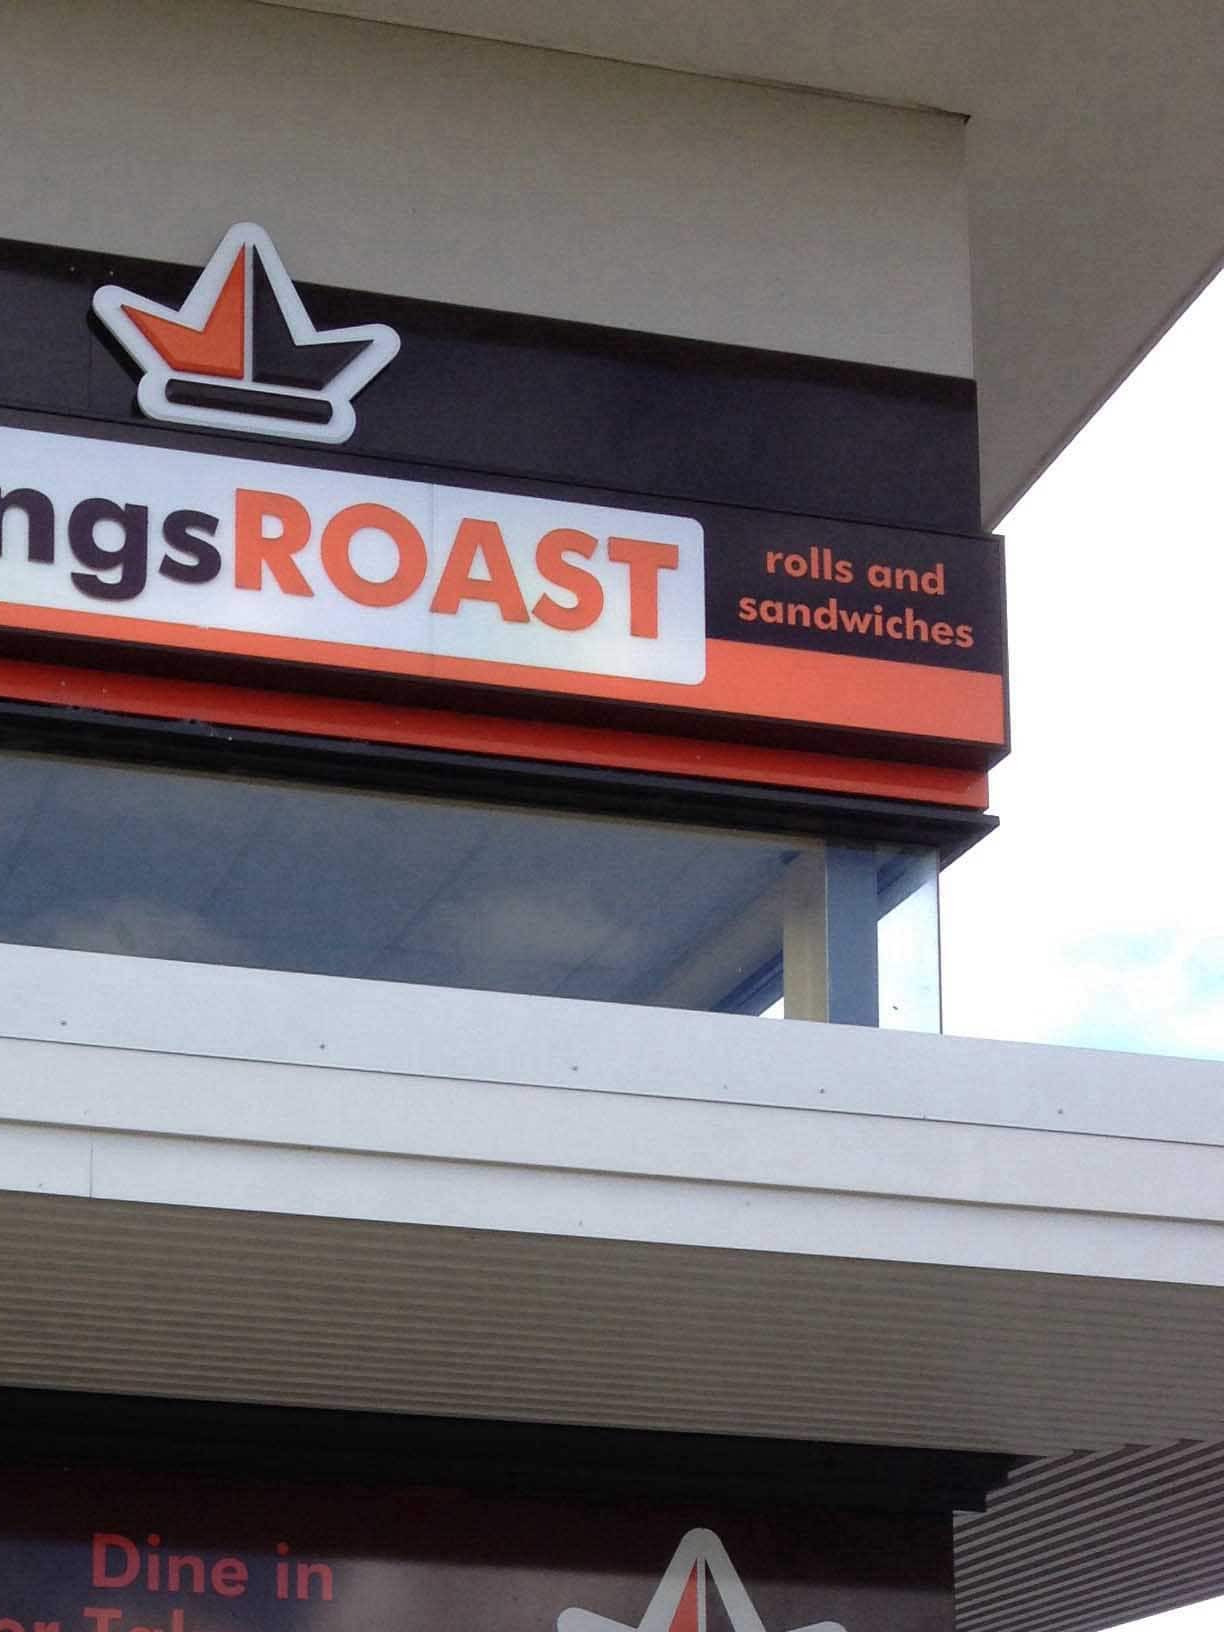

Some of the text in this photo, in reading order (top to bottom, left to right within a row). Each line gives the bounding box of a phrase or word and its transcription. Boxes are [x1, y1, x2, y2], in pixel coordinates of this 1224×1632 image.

[765, 546, 946, 597] rolls and
[737, 592, 975, 649] sandwiches
[91, 1532, 333, 1601] Dine in
